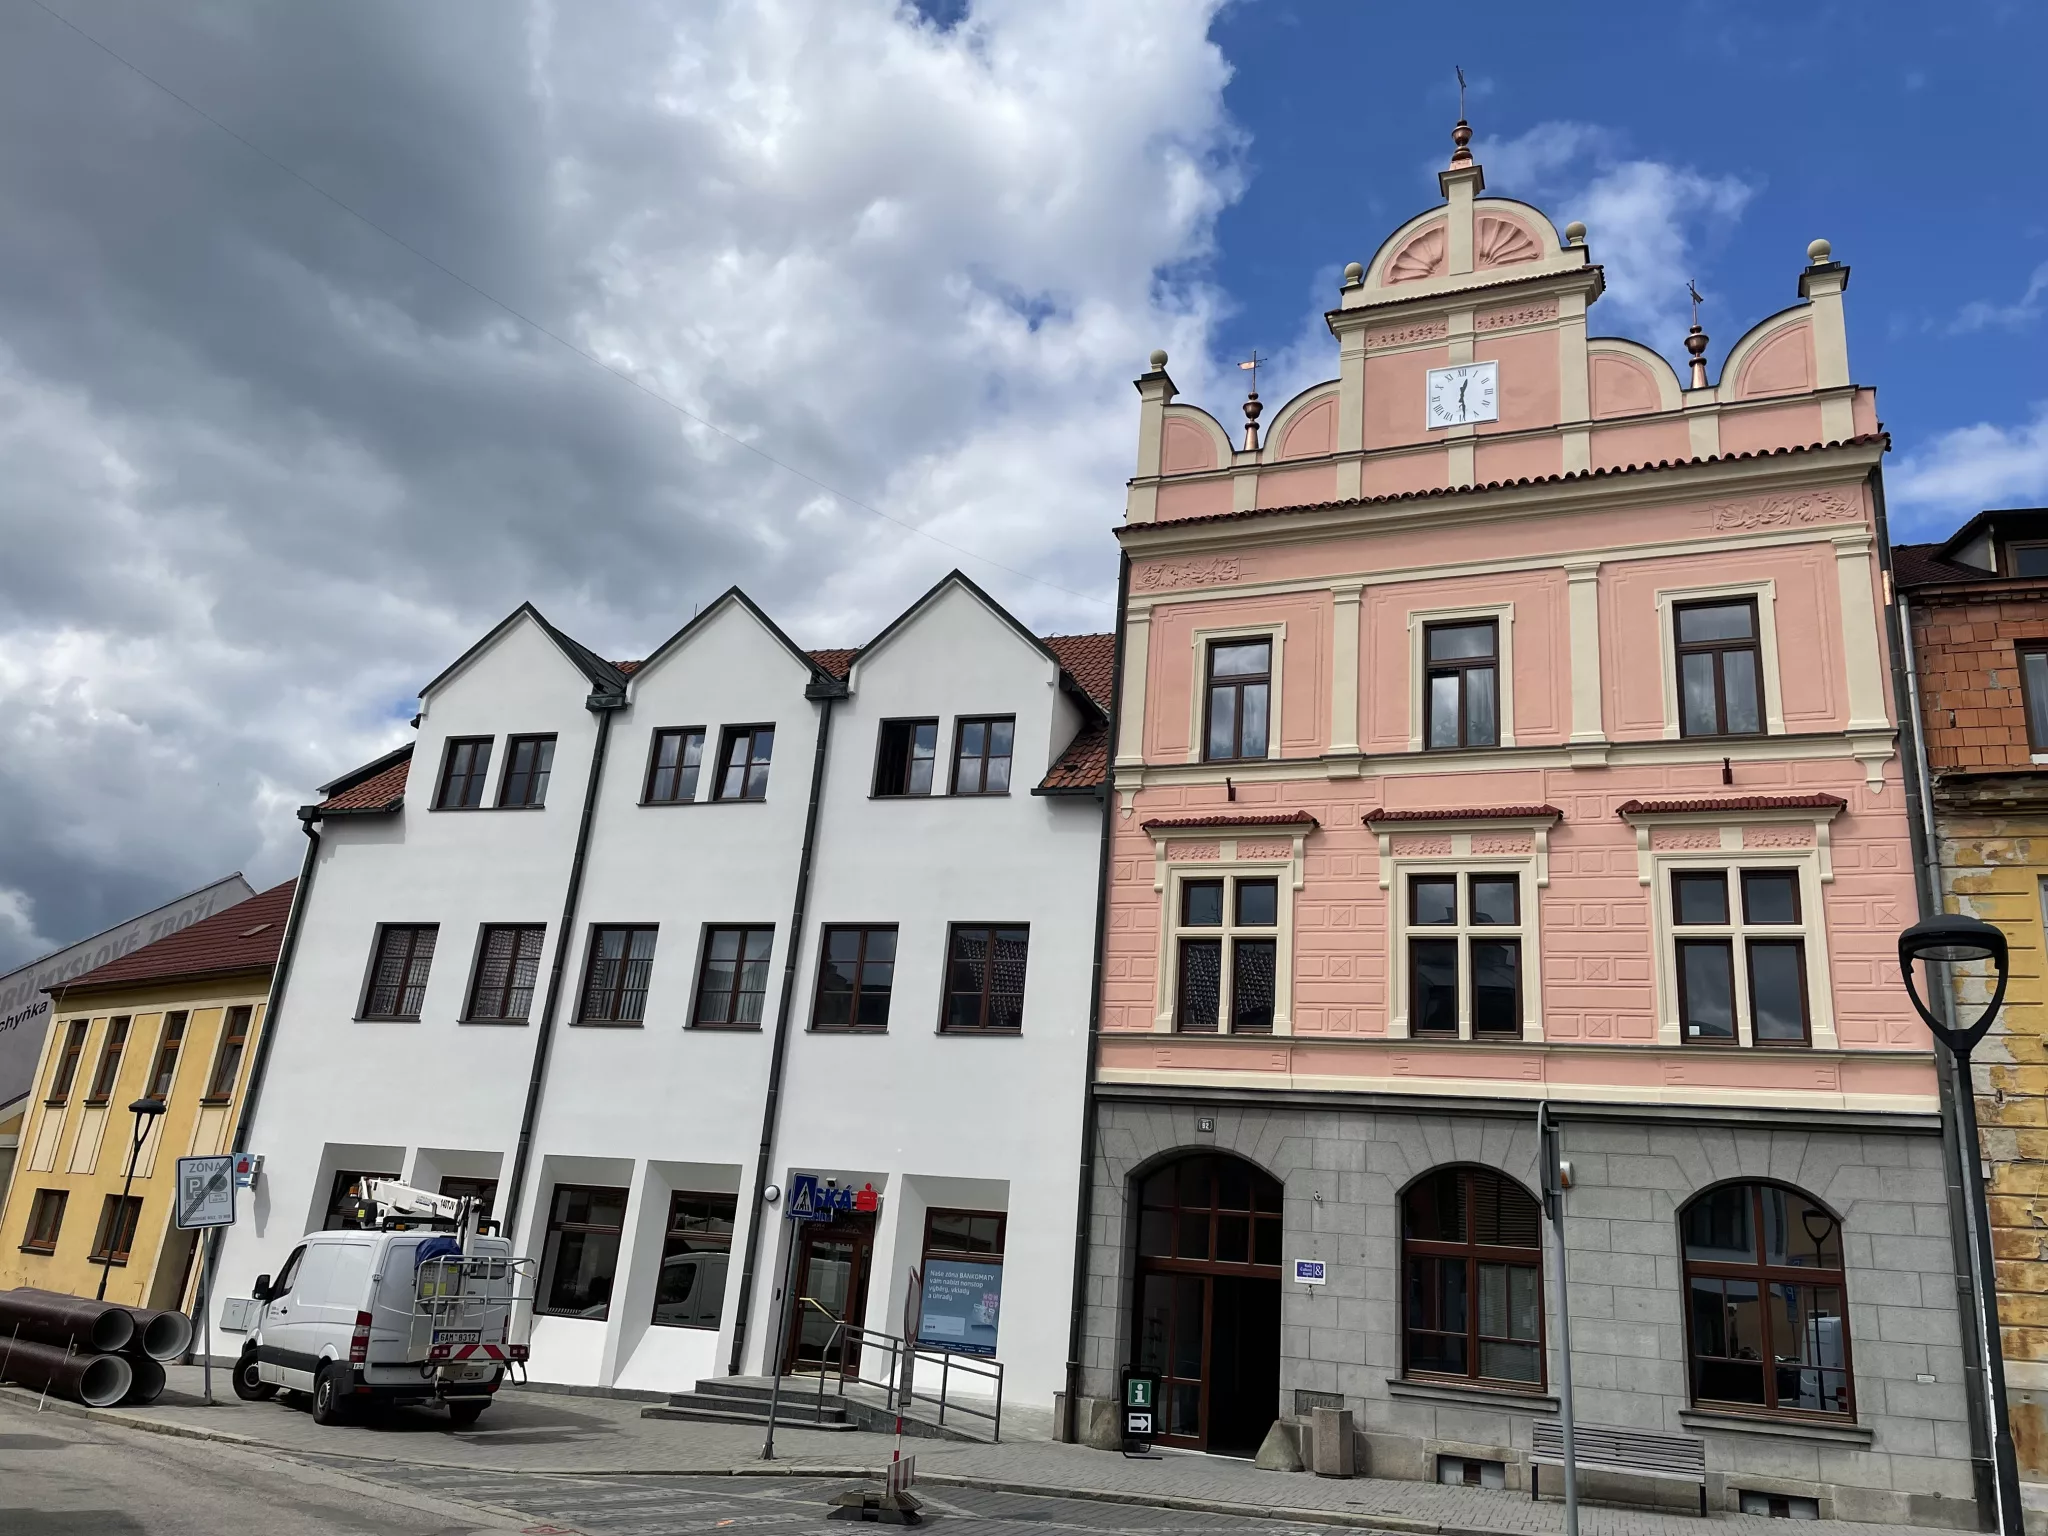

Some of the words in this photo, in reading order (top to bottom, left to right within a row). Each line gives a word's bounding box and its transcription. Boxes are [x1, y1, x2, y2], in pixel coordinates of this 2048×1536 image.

[0, 923, 140, 1016] RŮMYSLOVÉ
[148, 892, 217, 945] ZBOŽÍ
[189, 1161, 224, 1173] ZÓNA
[959, 1272, 995, 1281] BANKOMATY
